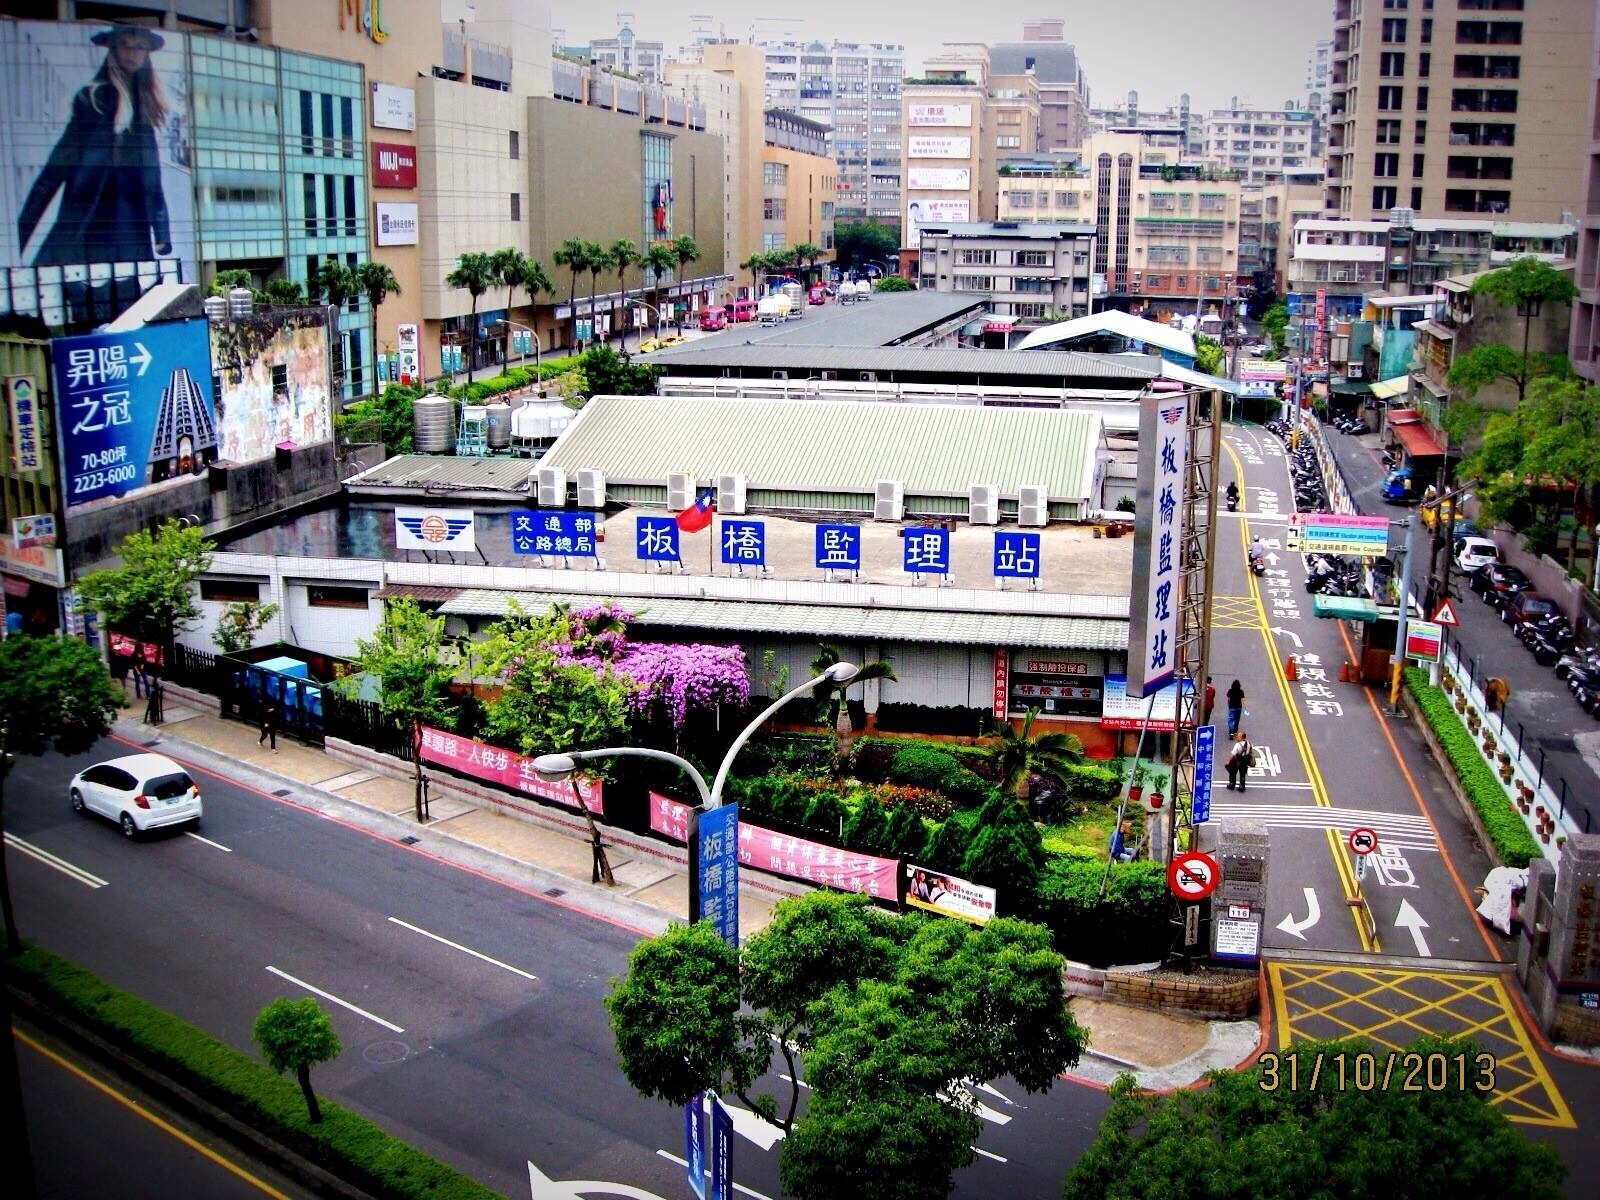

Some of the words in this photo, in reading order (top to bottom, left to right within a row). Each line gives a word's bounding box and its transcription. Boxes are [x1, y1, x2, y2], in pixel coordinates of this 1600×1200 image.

[379, 151, 398, 170] MUJI
[67, 345, 128, 389] 昇陽
[71, 391, 132, 436] 之冠
[81, 445, 127, 470] 70-80坪
[74, 464, 136, 494] 2223-6000
[516, 515, 592, 532] 交通部
[516, 535, 592, 553] 公路總局
[639, 522, 1038, 575] 板橋監理站
[1152, 436, 1178, 670] 板橋監理站
[1231, 910, 1248, 918] 116
